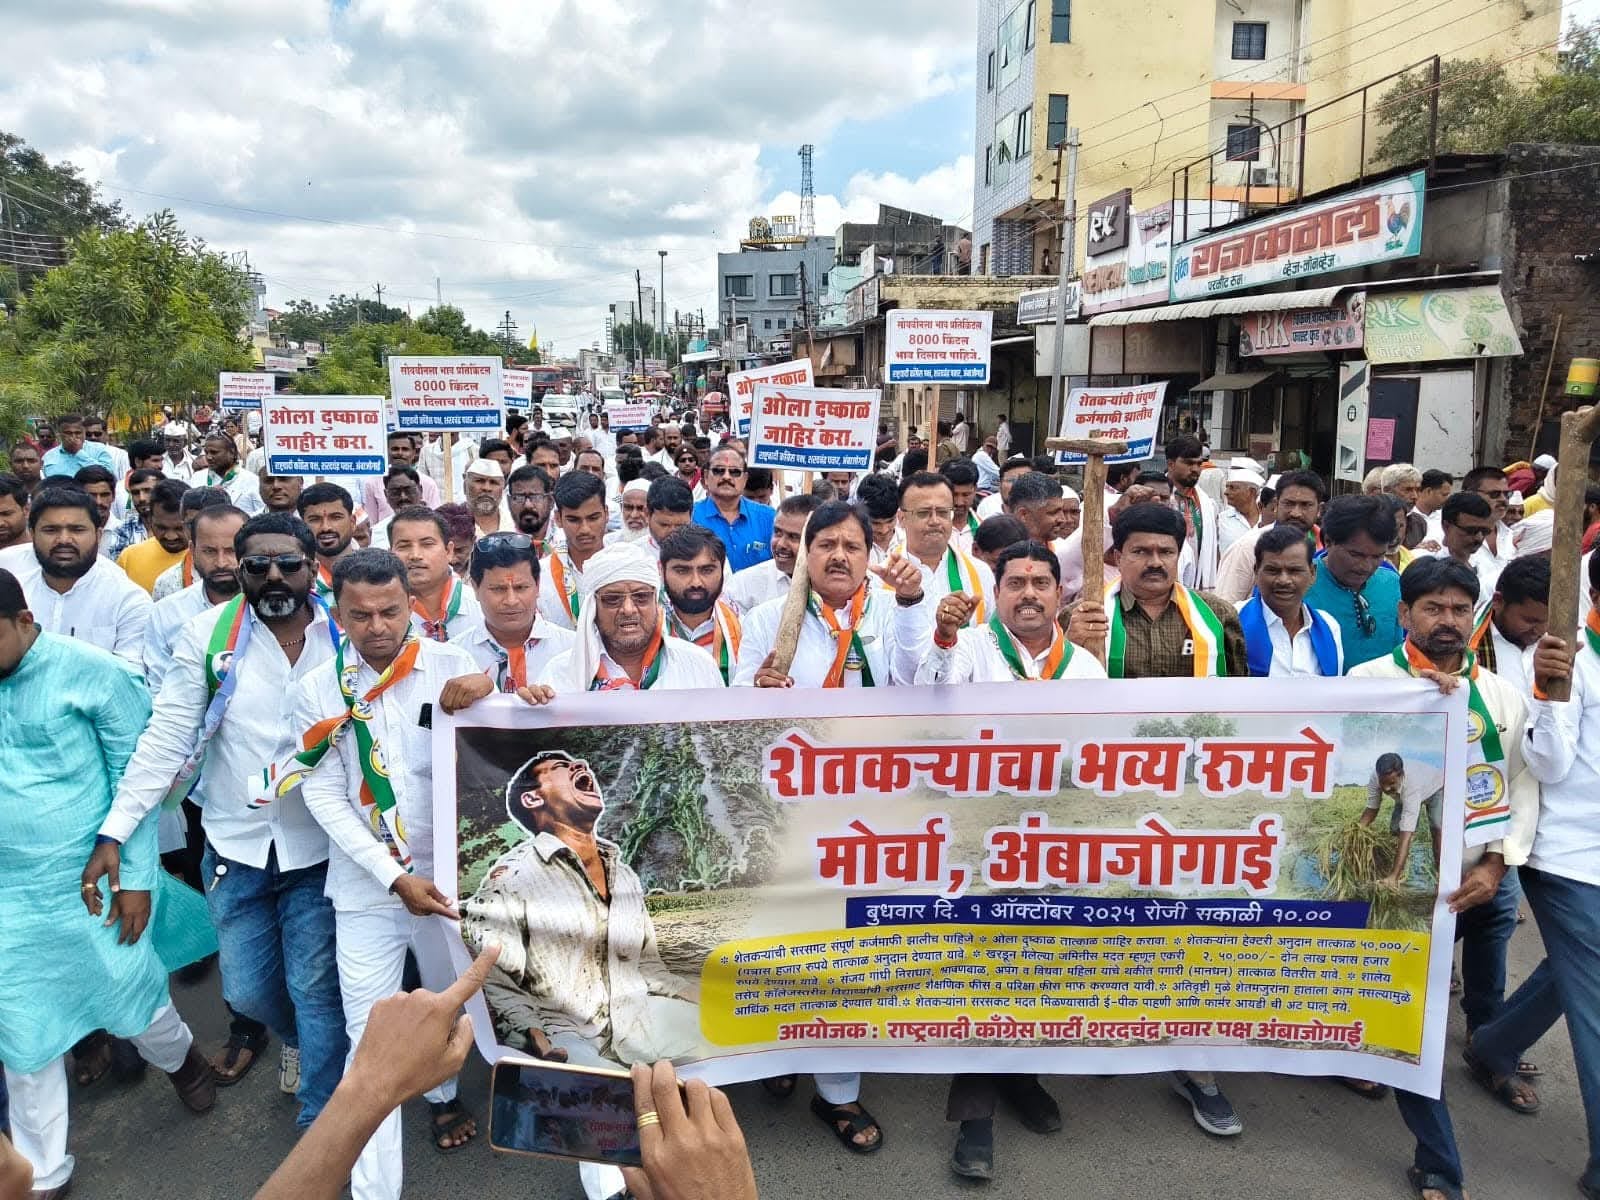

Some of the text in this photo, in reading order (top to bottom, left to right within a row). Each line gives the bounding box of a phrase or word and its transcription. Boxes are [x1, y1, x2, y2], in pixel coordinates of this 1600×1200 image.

[909, 334, 940, 344] 8000
[1254, 311, 1291, 350] RK
[896, 351, 914, 359] भाव
[917, 349, 947, 359] दिलाच
[415, 381, 447, 390] 8000
[402, 397, 422, 406] भाव
[423, 396, 457, 406] दिलाच
[763, 392, 811, 417] ओला
[814, 401, 871, 425] दुष्काळ
[1079, 392, 1134, 407] शेतकऱ्यांची
[271, 407, 379, 432] ओला दुष्काळ
[1075, 407, 1153, 424] कर्जमाफी झालीच
[277, 432, 372, 452] जाहीर करा.
[764, 422, 815, 448] जाहिर
[819, 429, 862, 446] करा..
[770, 729, 1334, 797] शेतकऱ्यांचा भव्य रुमने
[817, 817, 1277, 892] मोर्चा, अंबाजोगाई
[866, 898, 1331, 927] बुधवार दि. १ ऑक्टोंबर २०२५ रोजी सकाळी १०.००
[734, 945, 785, 962] शेतकऱ्यांची
[790, 944, 826, 955] सरसगट
[831, 937, 854, 953] संपूर्ण
[859, 934, 902, 947] कर्जमाफी
[907, 932, 938, 945] झालीच
[944, 932, 974, 944] पाहिजे
[992, 933, 1018, 943] ओला
[1061, 937, 1099, 946] तात्काळ
[1103, 935, 1132, 947] जाहिर
[1136, 937, 1167, 945] करावा.
[1187, 934, 1238, 944] शेतकऱ्यांना
[1278, 938, 1312, 949] अनुदान
[1317, 939, 1356, 948] तात्काळ
[776, 965, 801, 976] हजार
[806, 958, 827, 970] रुपये
[833, 956, 869, 968] तात्काळ
[874, 953, 907, 966] अनुदान
[912, 950, 942, 961] देण्यात
[986, 950, 1016, 962] खरडून
[1021, 948, 1054, 960] गेलेल्या
[1059, 950, 1098, 960] जमिनीस
[1103, 952, 1125, 961] मदत
[1160, 949, 1185, 961] एकरी
[1281, 951, 1298, 962] दोन
[1304, 954, 1326, 963] लाख
[1331, 956, 1358, 964] पन्नास
[1363, 957, 1389, 966] हजार
[840, 974, 865, 984] संजय
[870, 968, 890, 980] गांधी
[1034, 965, 1063, 975] विधवा
[1068, 965, 1096, 976] महिला
[1189, 966, 1232, 977] (मानधन)
[1238, 968, 1276, 976] तात्काळ
[1281, 966, 1316, 978] वितरीत
[1362, 970, 1391, 982] शालेय
[969, 979, 991, 990] फीस
[995, 982, 1002, 990] व
[1007, 980, 1035, 991] परिक्षा
[1040, 980, 1061, 990] फीस
[1090, 982, 1129, 990] करण्यात
[1215, 983, 1231, 995] मुळे
[1236, 981, 1289, 996] शेतमजुरांना
[1294, 986, 1328, 995] हाताला
[1333, 987, 1354, 996] काम
[1358, 989, 1411, 1004] नसल्यामुळे
[735, 1003, 769, 1015] आर्थिक
[774, 1003, 795, 1012] मदत
[800, 1000, 837, 1010] तात्काळ
[842, 997, 872, 1008] देण्यात
[916, 994, 966, 1006] शेतकऱ्यांना
[971, 998, 1010, 1006] सरसकट
[1015, 998, 1036, 1007] मदत
[1041, 994, 1099, 1007] मिळण्यासाठी
[1142, 995, 1171, 1008] पाहणी
[1176, 996, 1200, 1007] आणि
[1235, 997, 1266, 1008] आयडी
[782, 1017, 1361, 1044] आयोजक राष्ट्रवादी काँग्रेस पार्टी शरदचंद्र पवार पक्ष अंबाजोगाई
